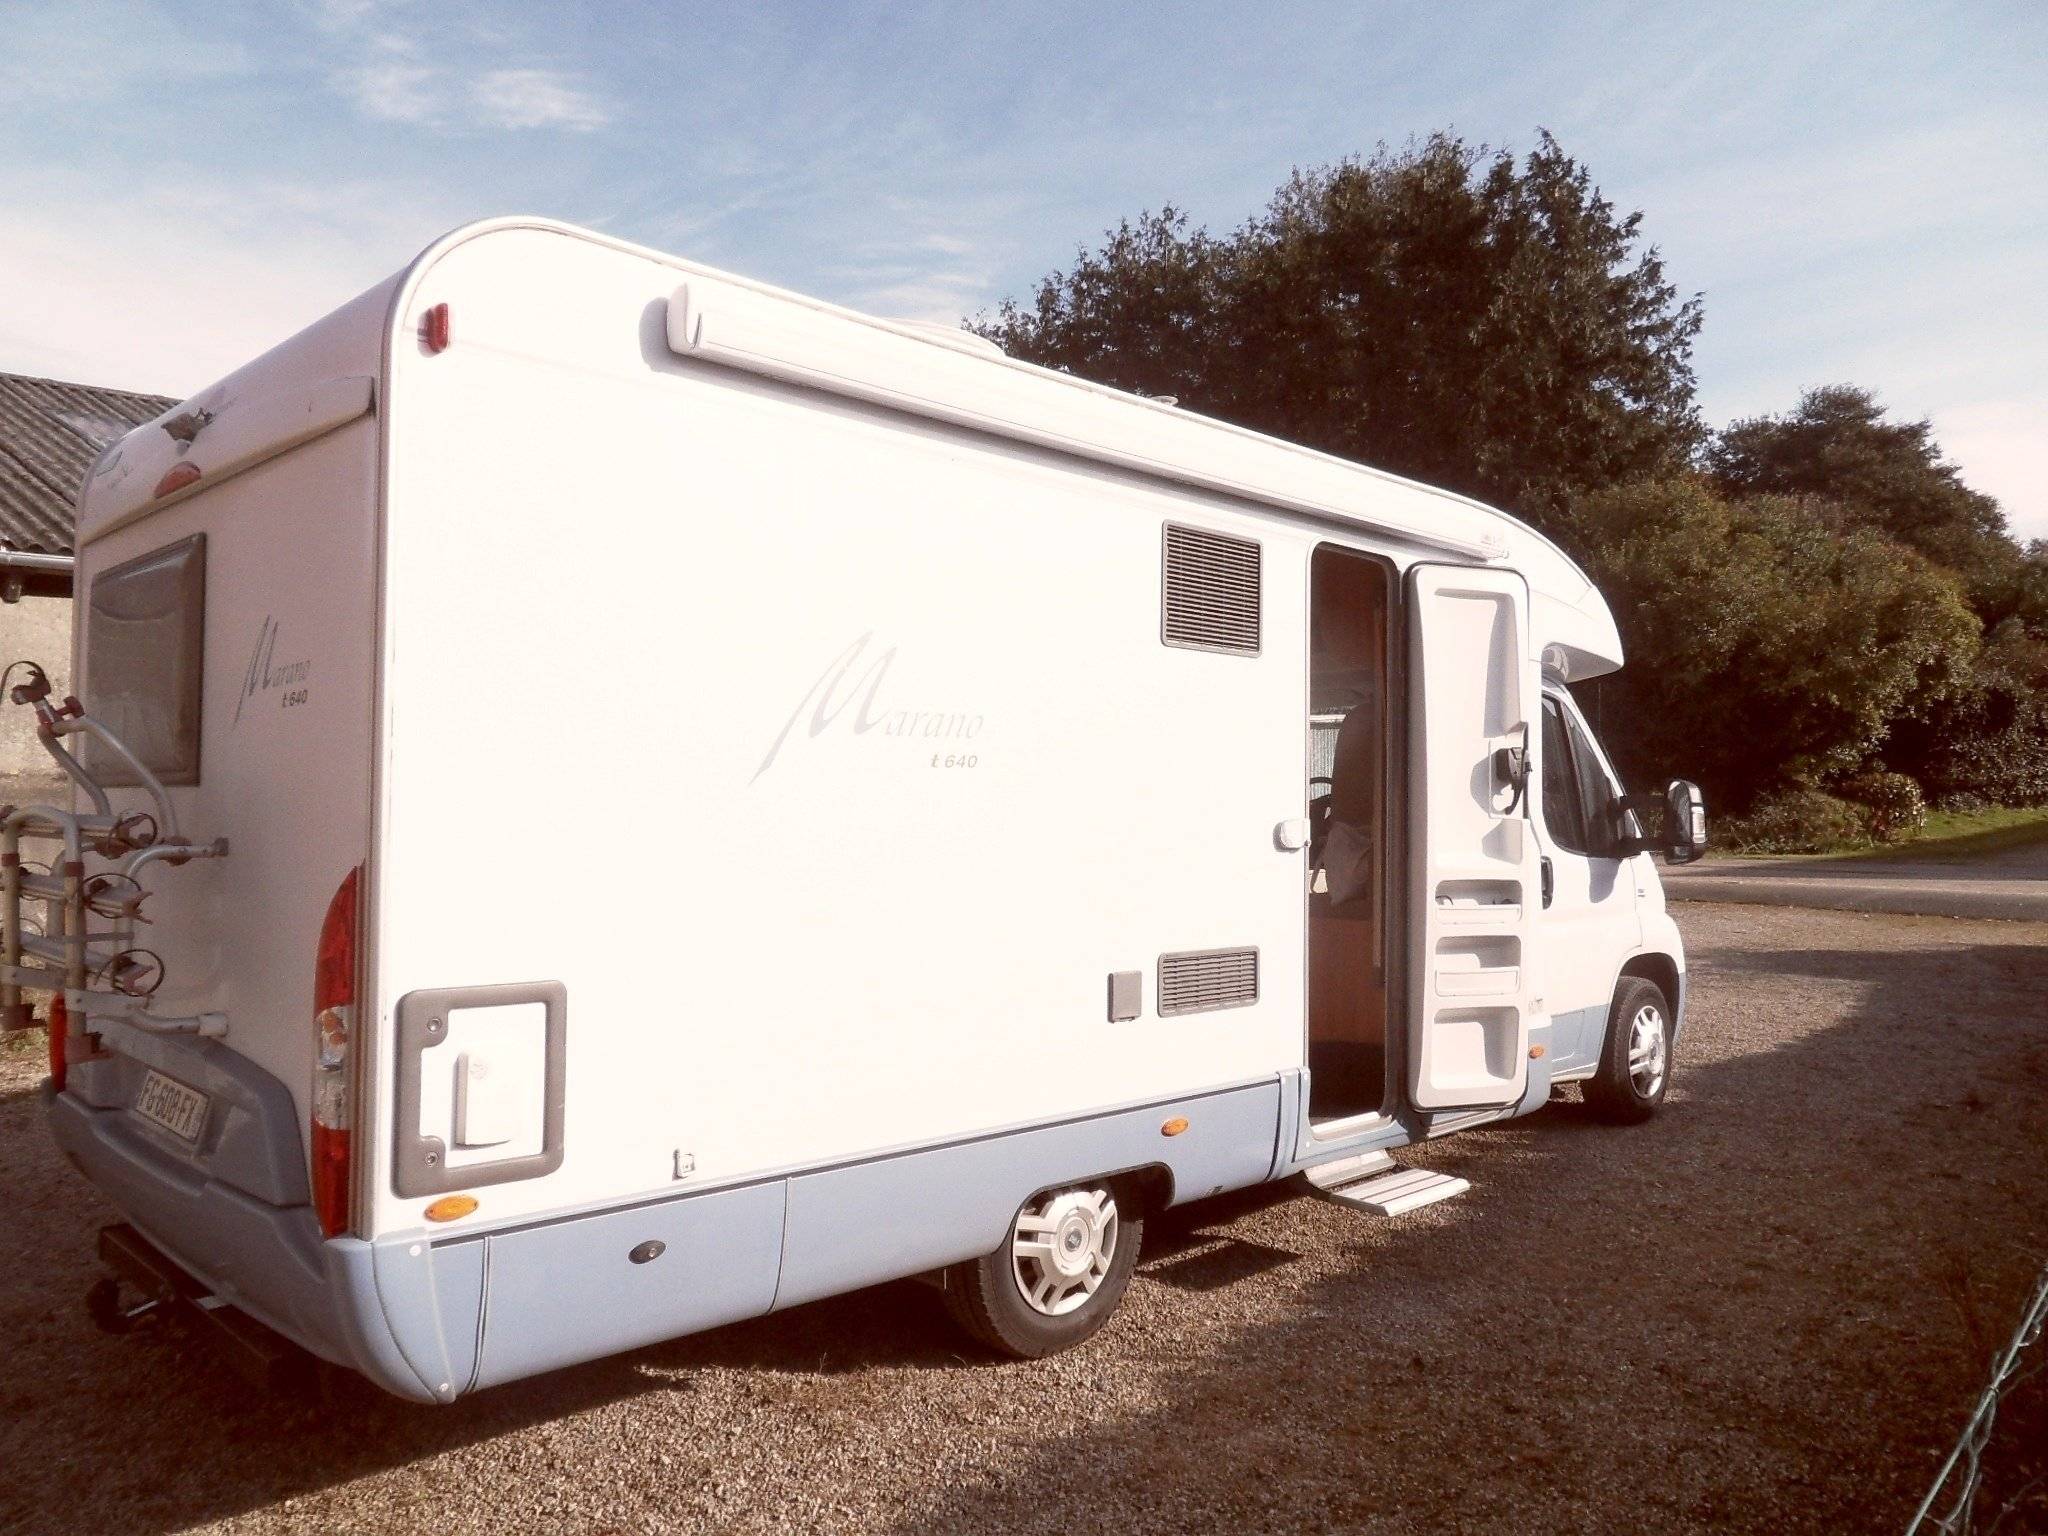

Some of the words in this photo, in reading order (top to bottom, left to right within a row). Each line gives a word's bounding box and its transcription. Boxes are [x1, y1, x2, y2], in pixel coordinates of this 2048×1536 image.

[232, 614, 311, 732] Marano
[289, 689, 309, 707] 640
[748, 629, 984, 787] Marano
[931, 753, 940, 769] t
[944, 754, 979, 769] 640
